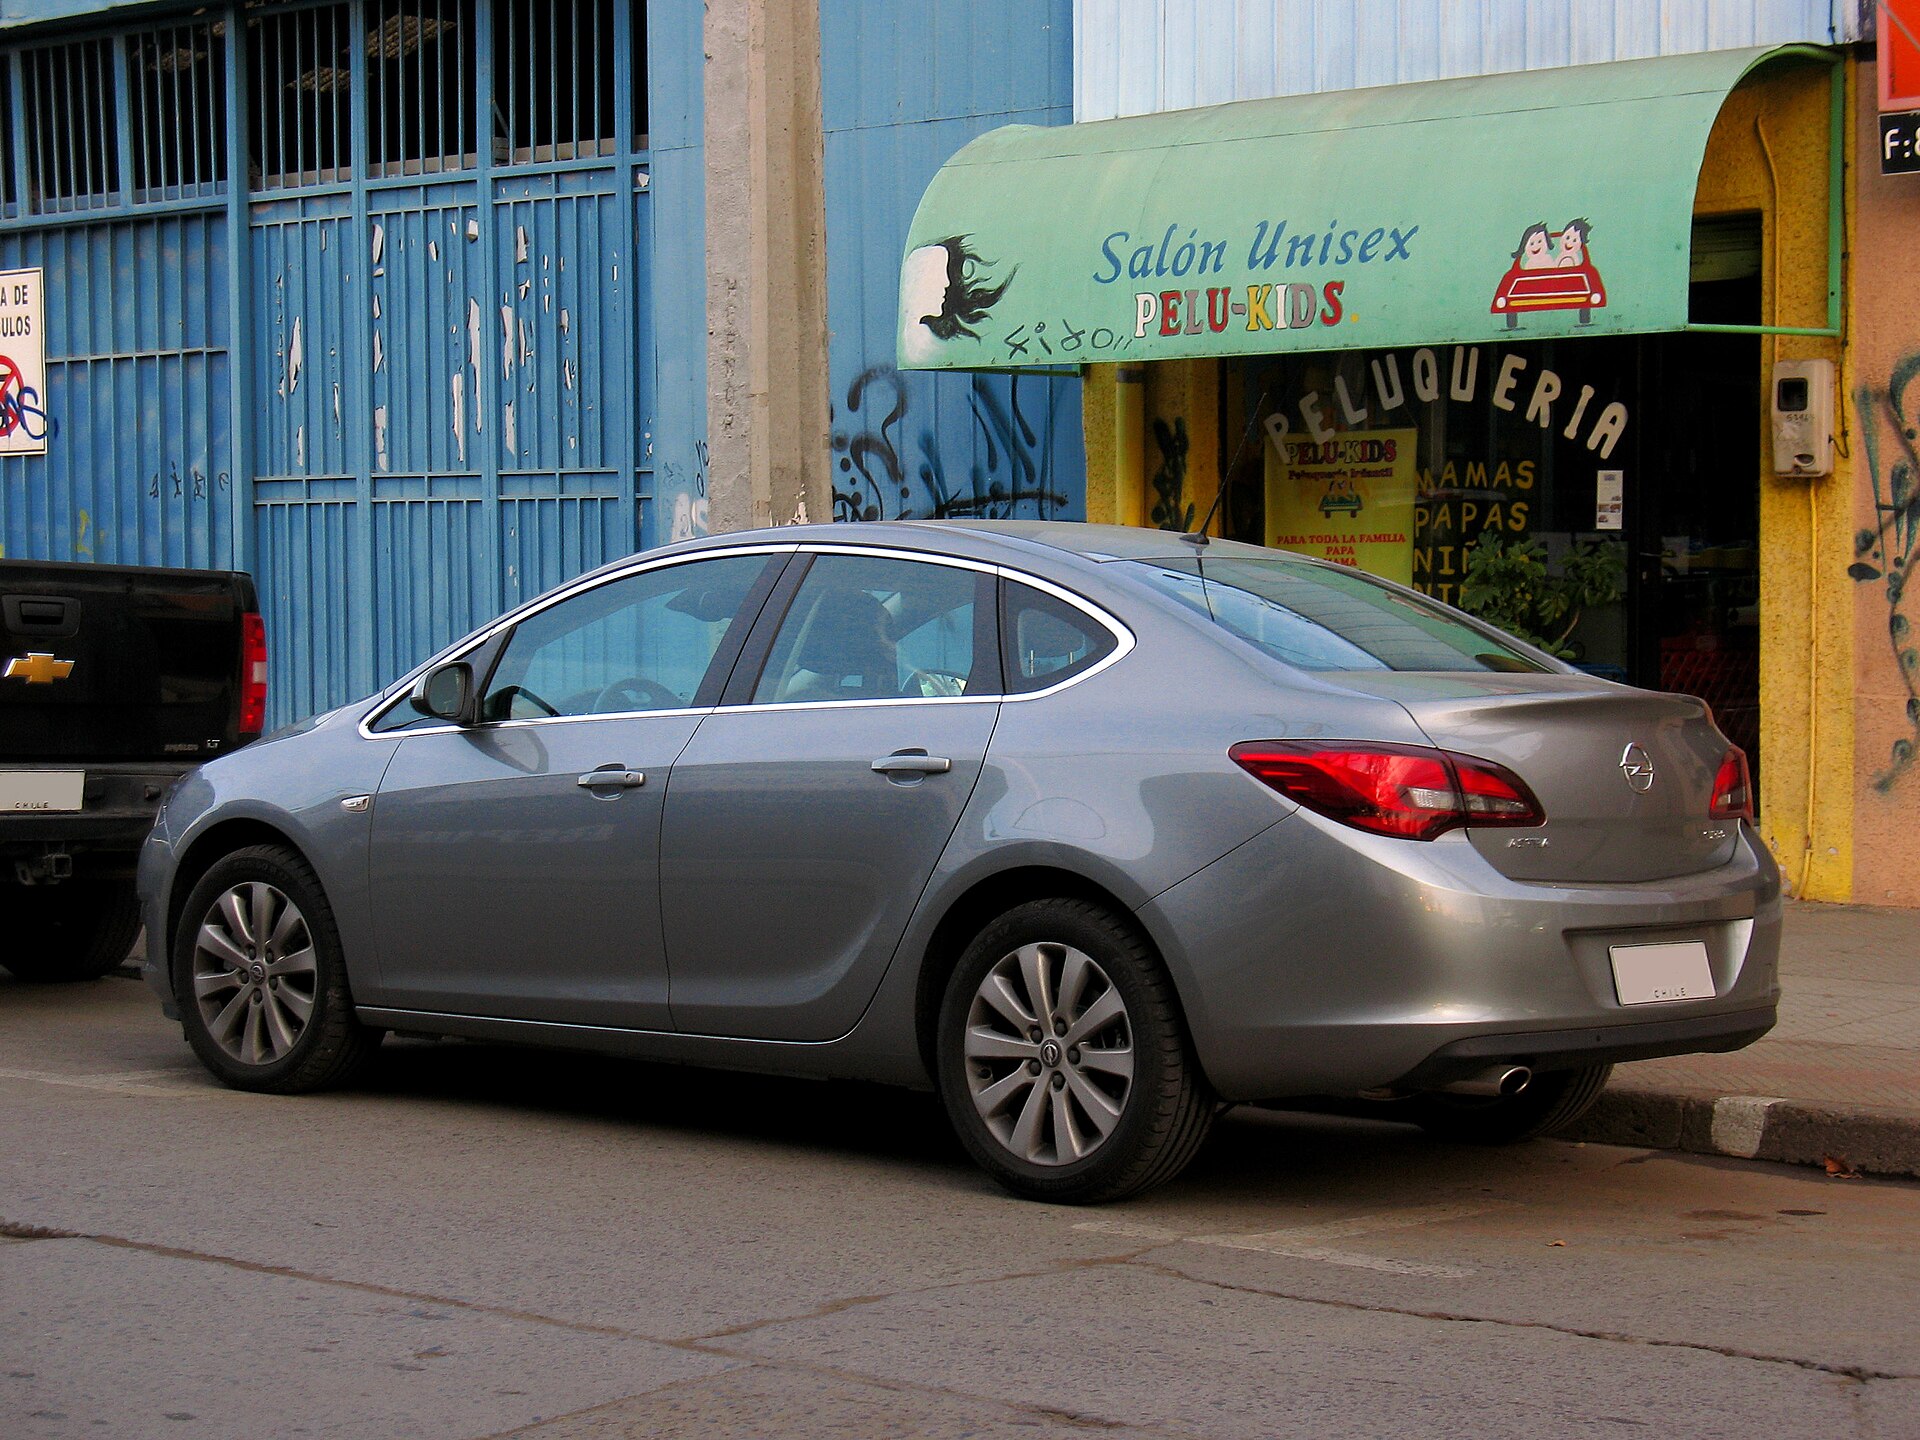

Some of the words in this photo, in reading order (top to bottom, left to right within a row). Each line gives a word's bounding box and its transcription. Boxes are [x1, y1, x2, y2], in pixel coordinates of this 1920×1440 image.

[1093, 223, 1228, 284] Salón
[1247, 219, 1420, 271] Unisex
[14, 284, 28, 305] DE
[0, 315, 31, 337] ULOS
[1263, 345, 1629, 464] PELUQUERIA
[1415, 460, 1536, 495] MAMAS
[1414, 502, 1529, 538] PAPAS
[1277, 535, 1306, 544] PARA
[1308, 535, 1338, 544] TODA
[1342, 534, 1357, 544] LA
[1359, 533, 1407, 543] FAMILIA
[1325, 546, 1355, 555] PAPA
[14, 801, 49, 810] CHILE
[1653, 987, 1686, 999] CHILE
